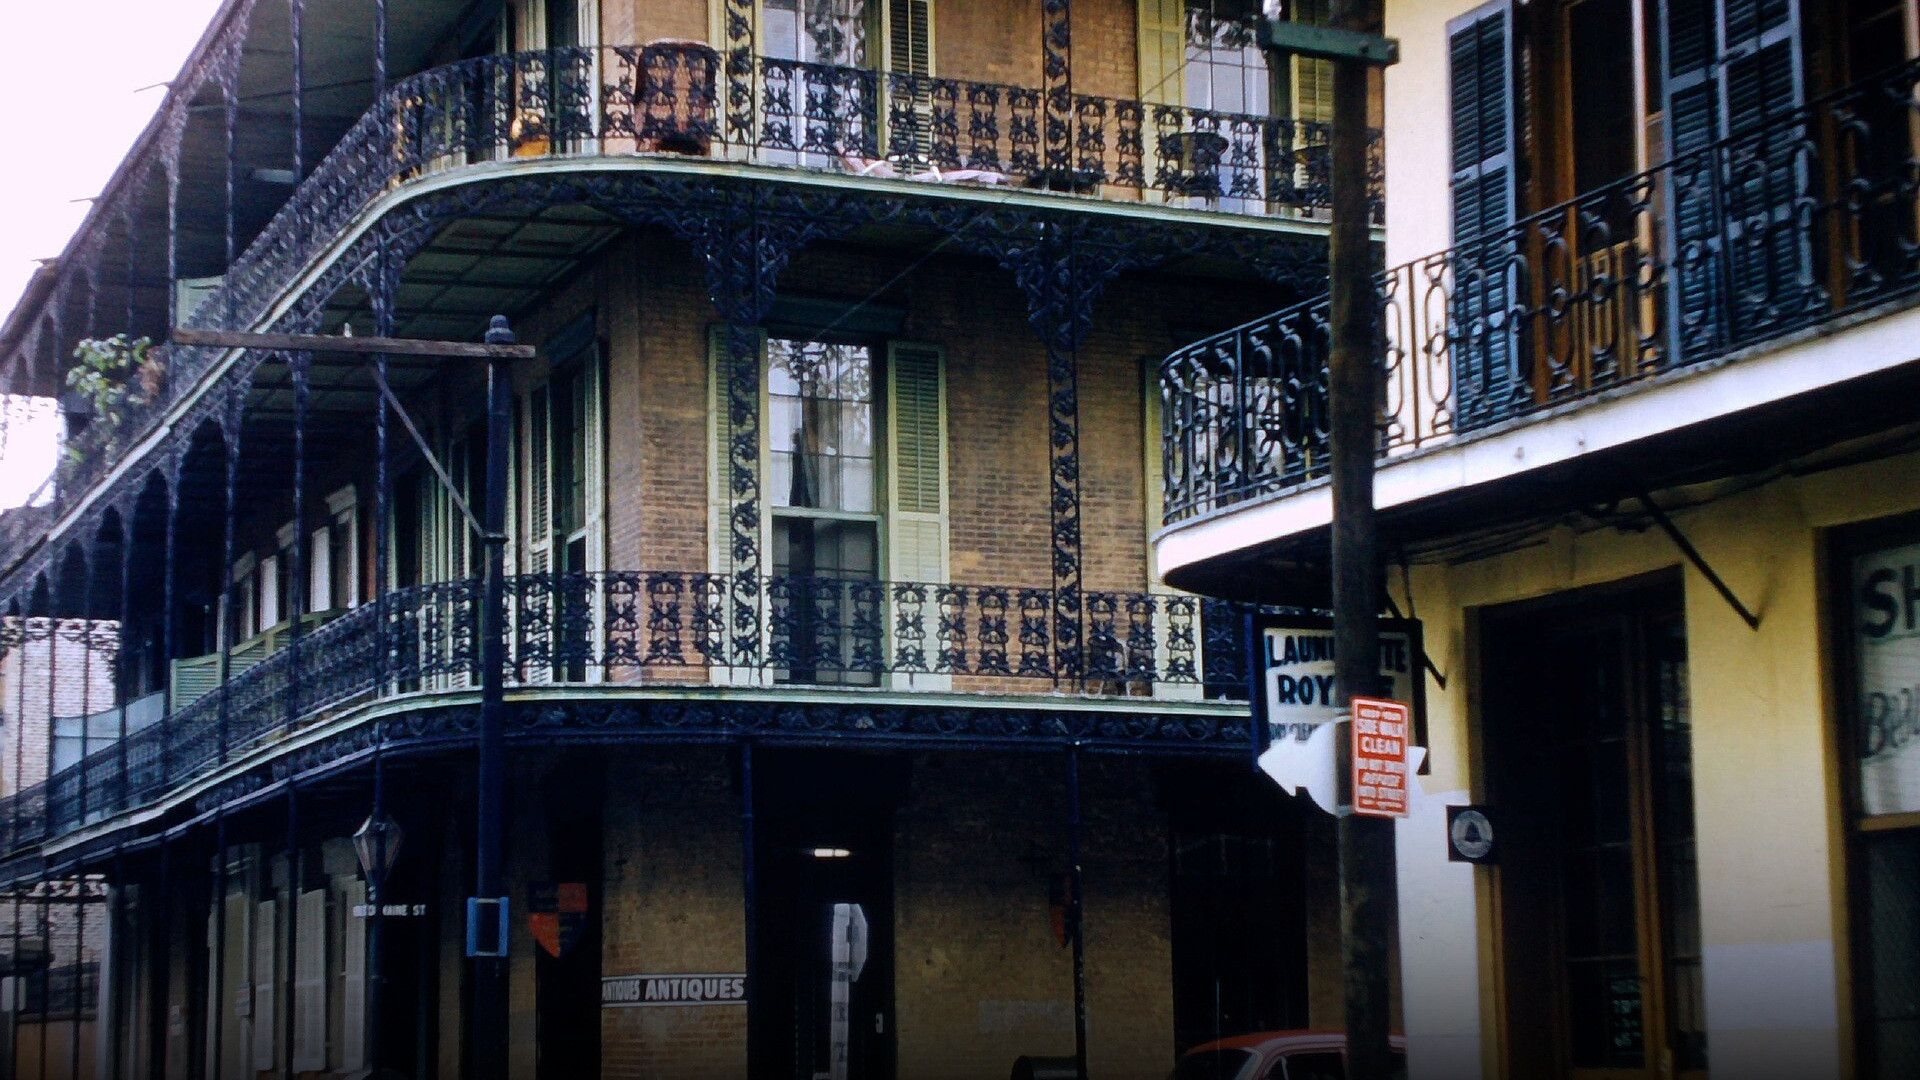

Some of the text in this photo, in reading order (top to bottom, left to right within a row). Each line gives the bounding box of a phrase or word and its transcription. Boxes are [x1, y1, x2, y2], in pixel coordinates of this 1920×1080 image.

[1361, 736, 1400, 755] CLEAN
[412, 904, 426, 916] ST
[645, 978, 744, 1001] ANTIQUES
